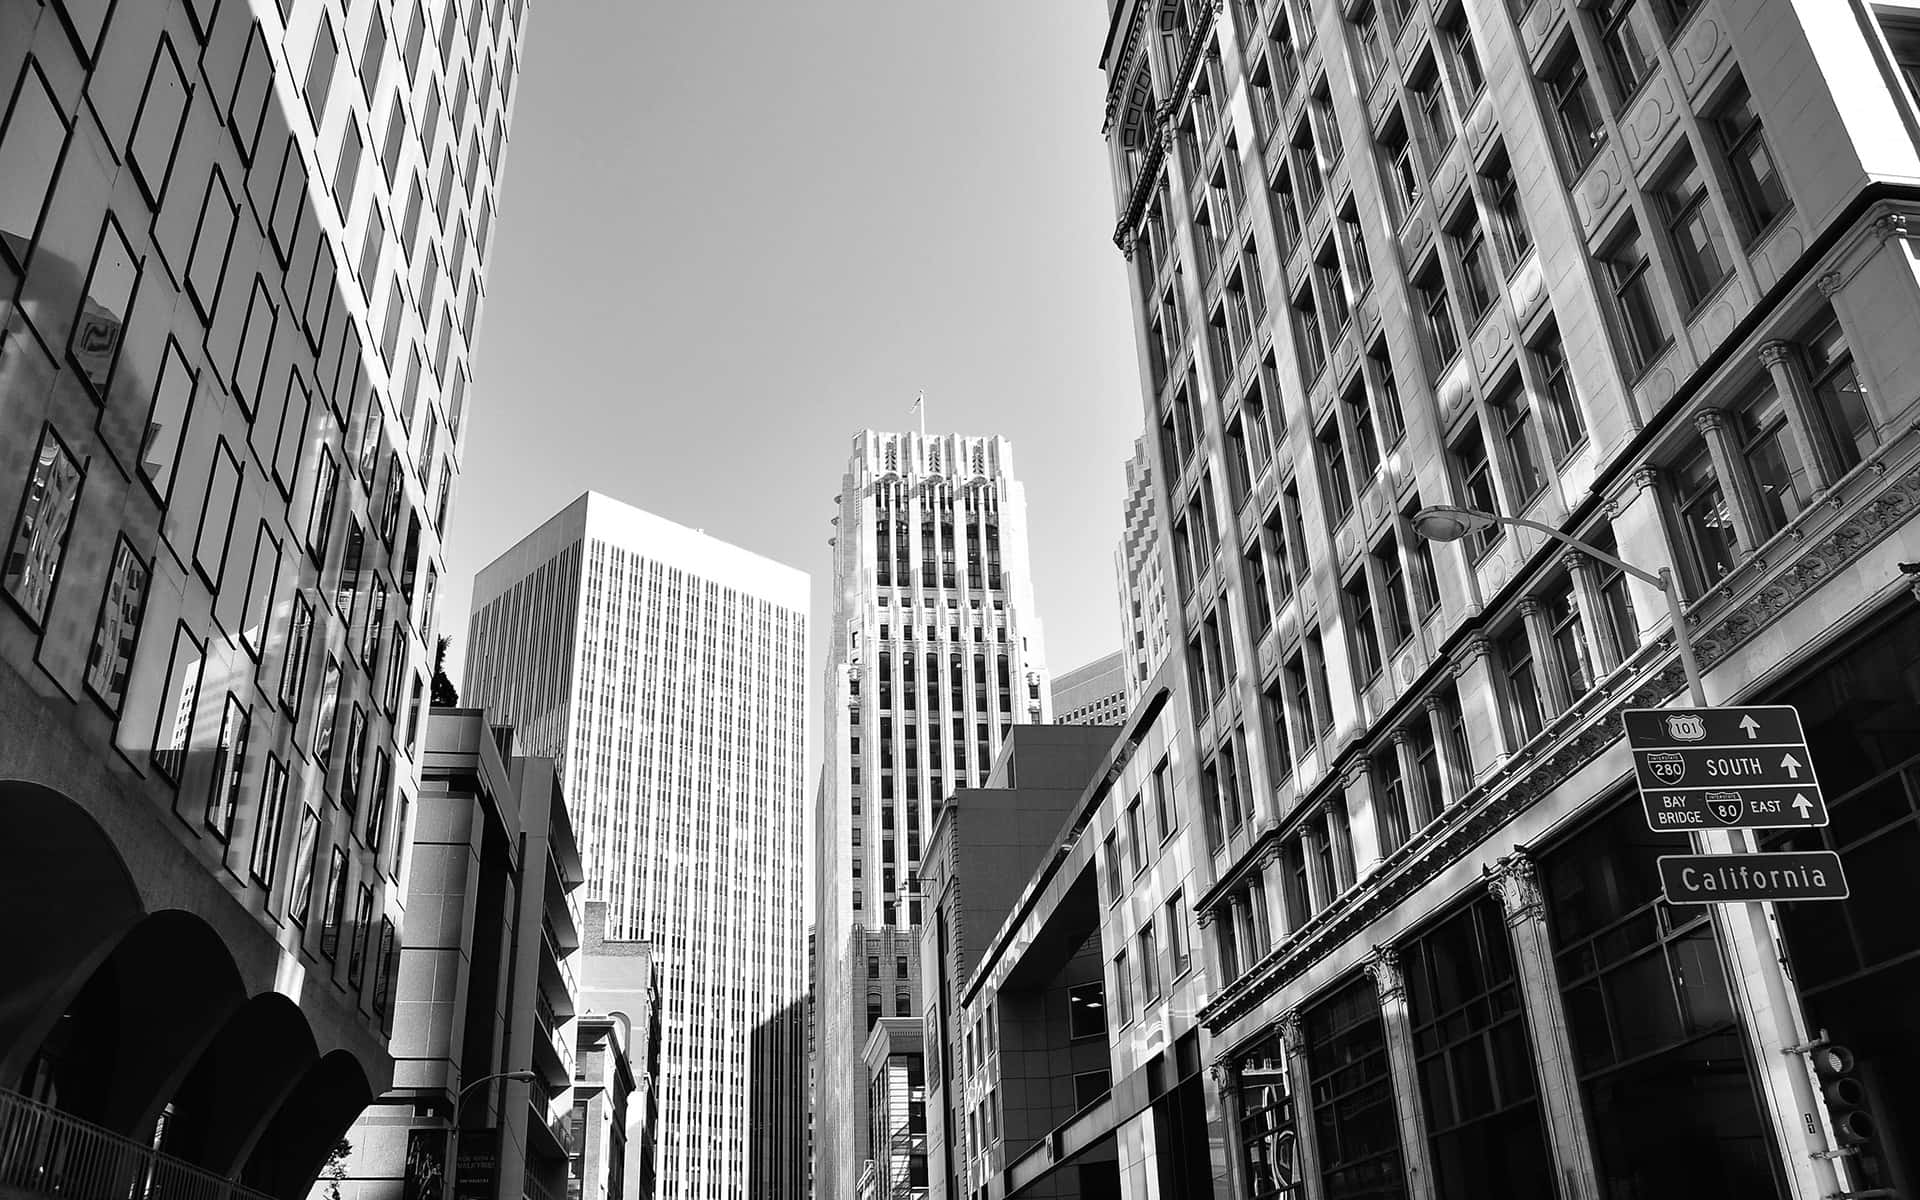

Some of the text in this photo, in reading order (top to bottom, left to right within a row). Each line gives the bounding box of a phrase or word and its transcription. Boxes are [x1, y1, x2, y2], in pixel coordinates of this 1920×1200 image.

[1675, 722, 1698, 735] 101
[1655, 758, 1763, 776] 280 SOUTH
[1663, 796, 1686, 808] BAY
[1718, 800, 1782, 817] 80 EAST
[1658, 811, 1703, 824] BRIDGE
[1681, 865, 1827, 891] California
